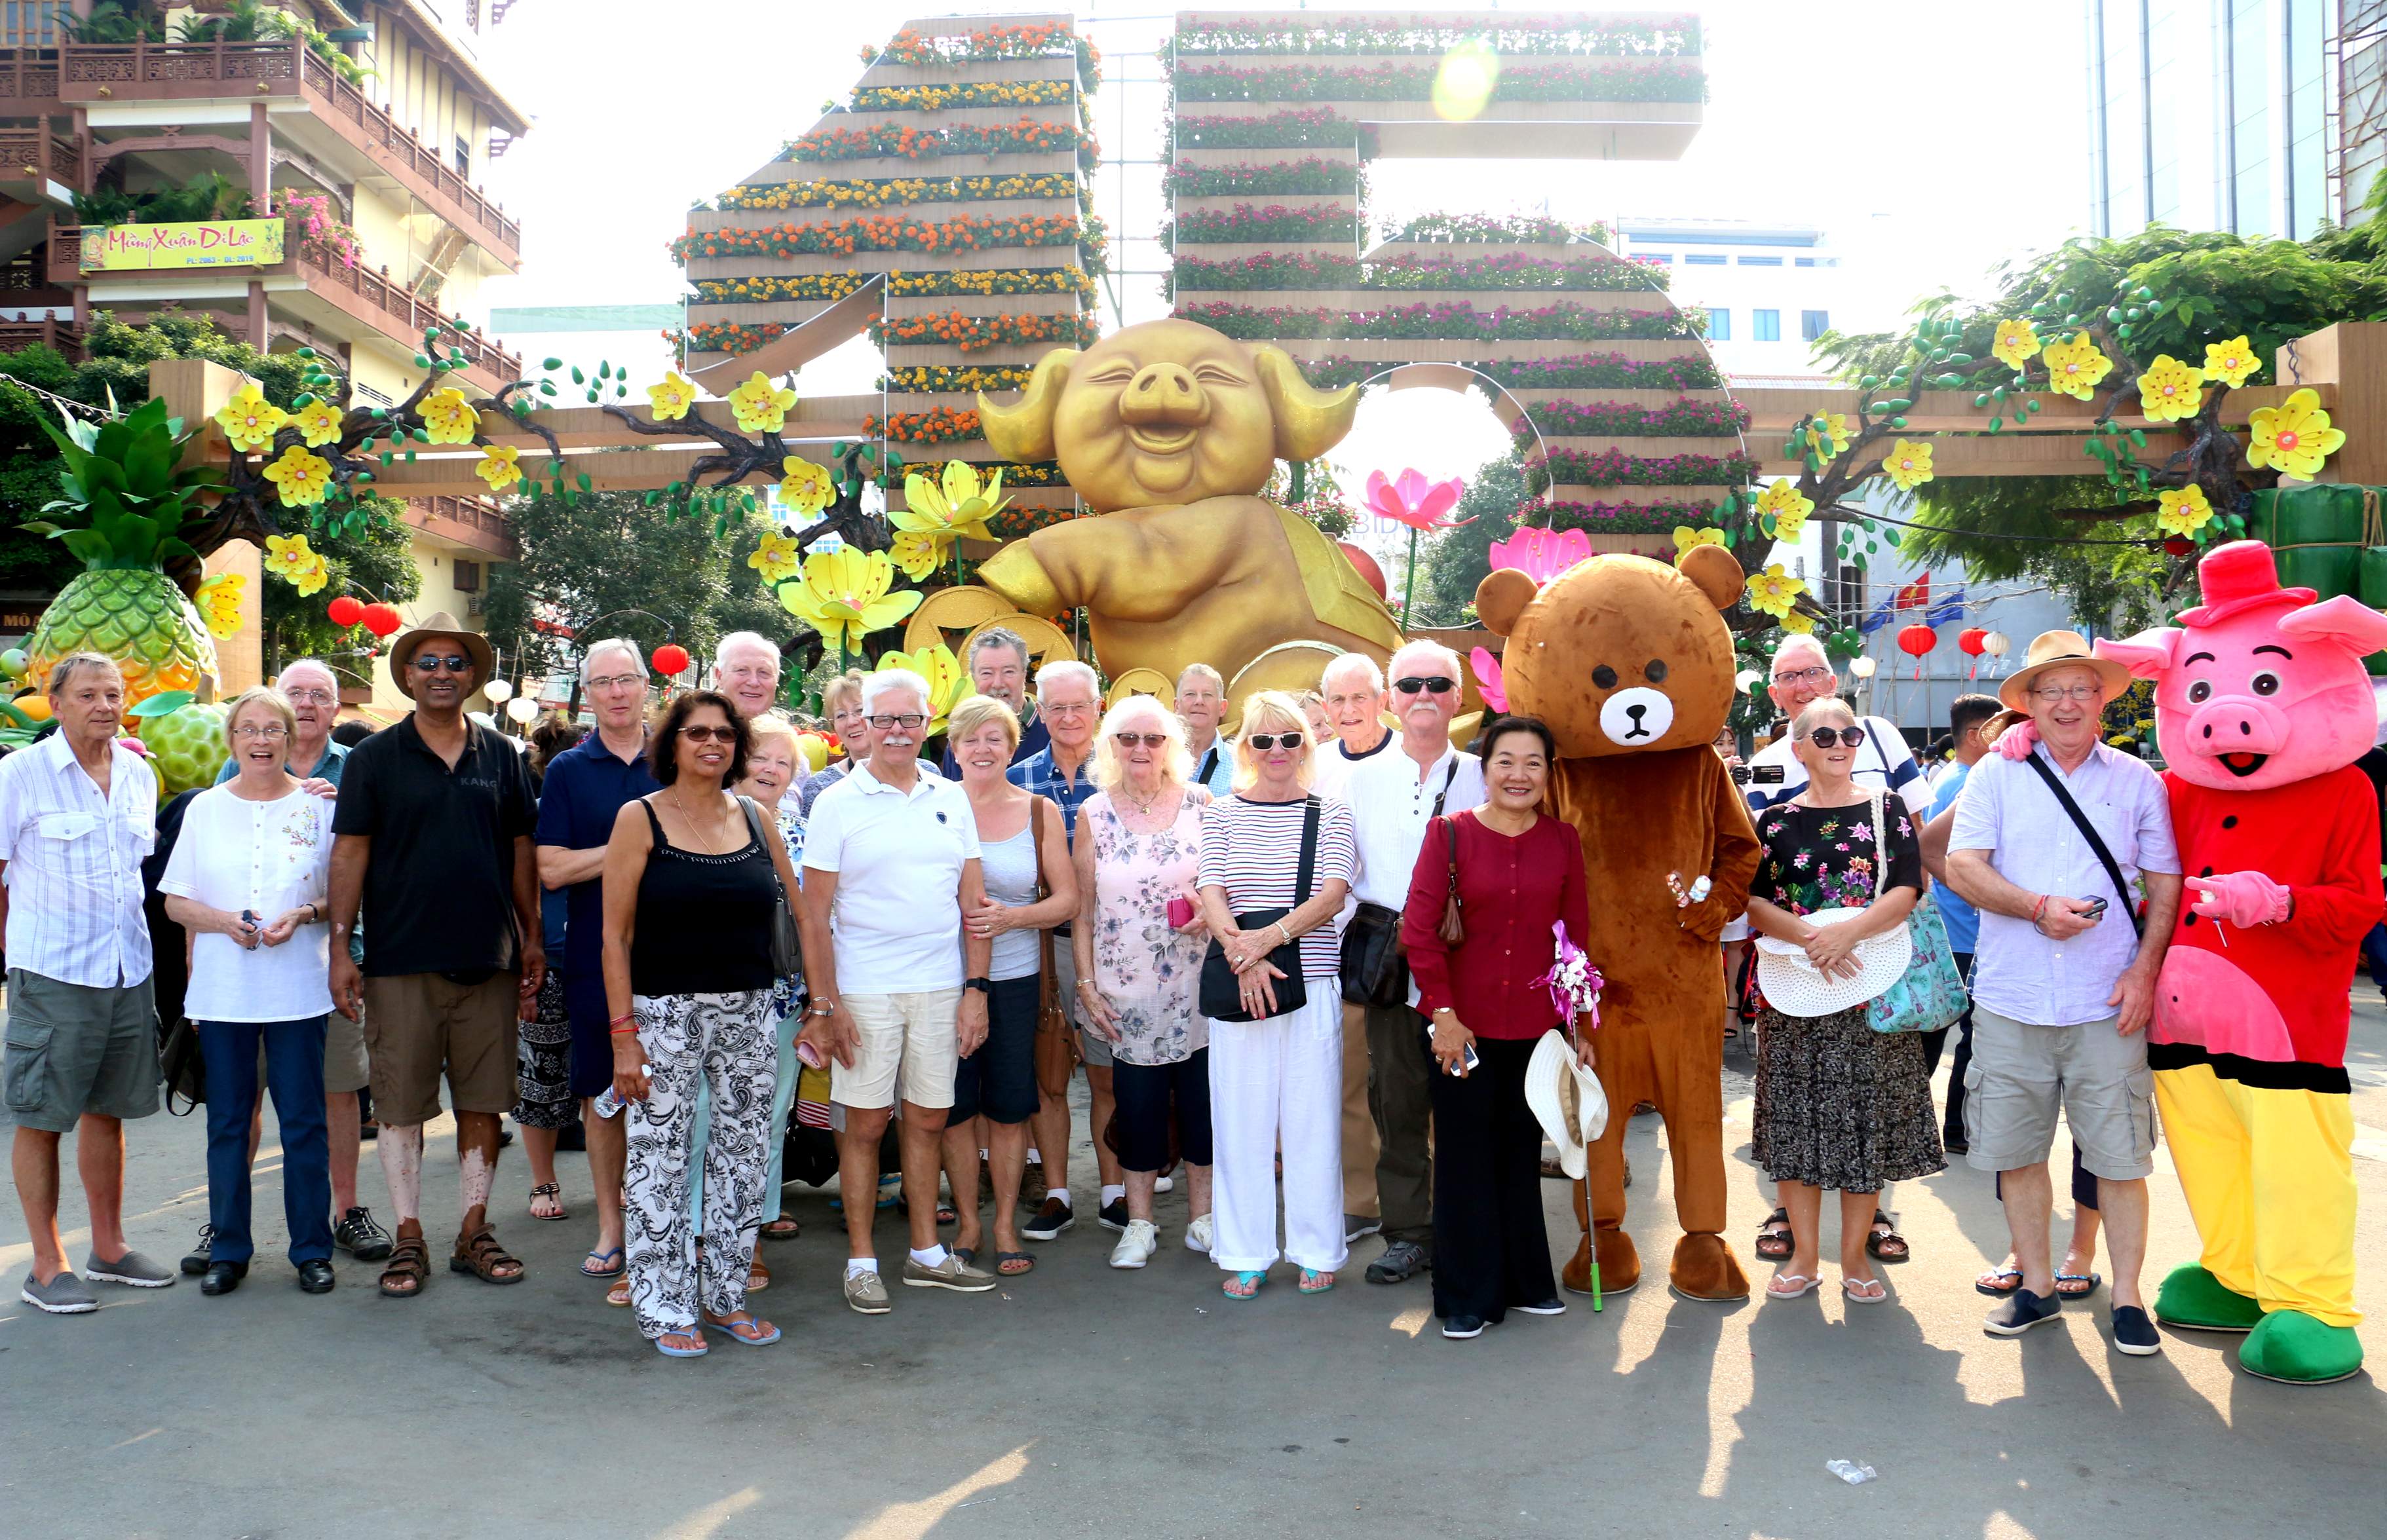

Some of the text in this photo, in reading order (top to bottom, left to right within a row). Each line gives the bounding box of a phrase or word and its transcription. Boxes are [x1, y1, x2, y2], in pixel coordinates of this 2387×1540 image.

[153, 227, 197, 250] Xuân
[198, 227, 227, 249] Di
[228, 225, 254, 247] Lặc
[1352, 512, 1411, 534] BID
